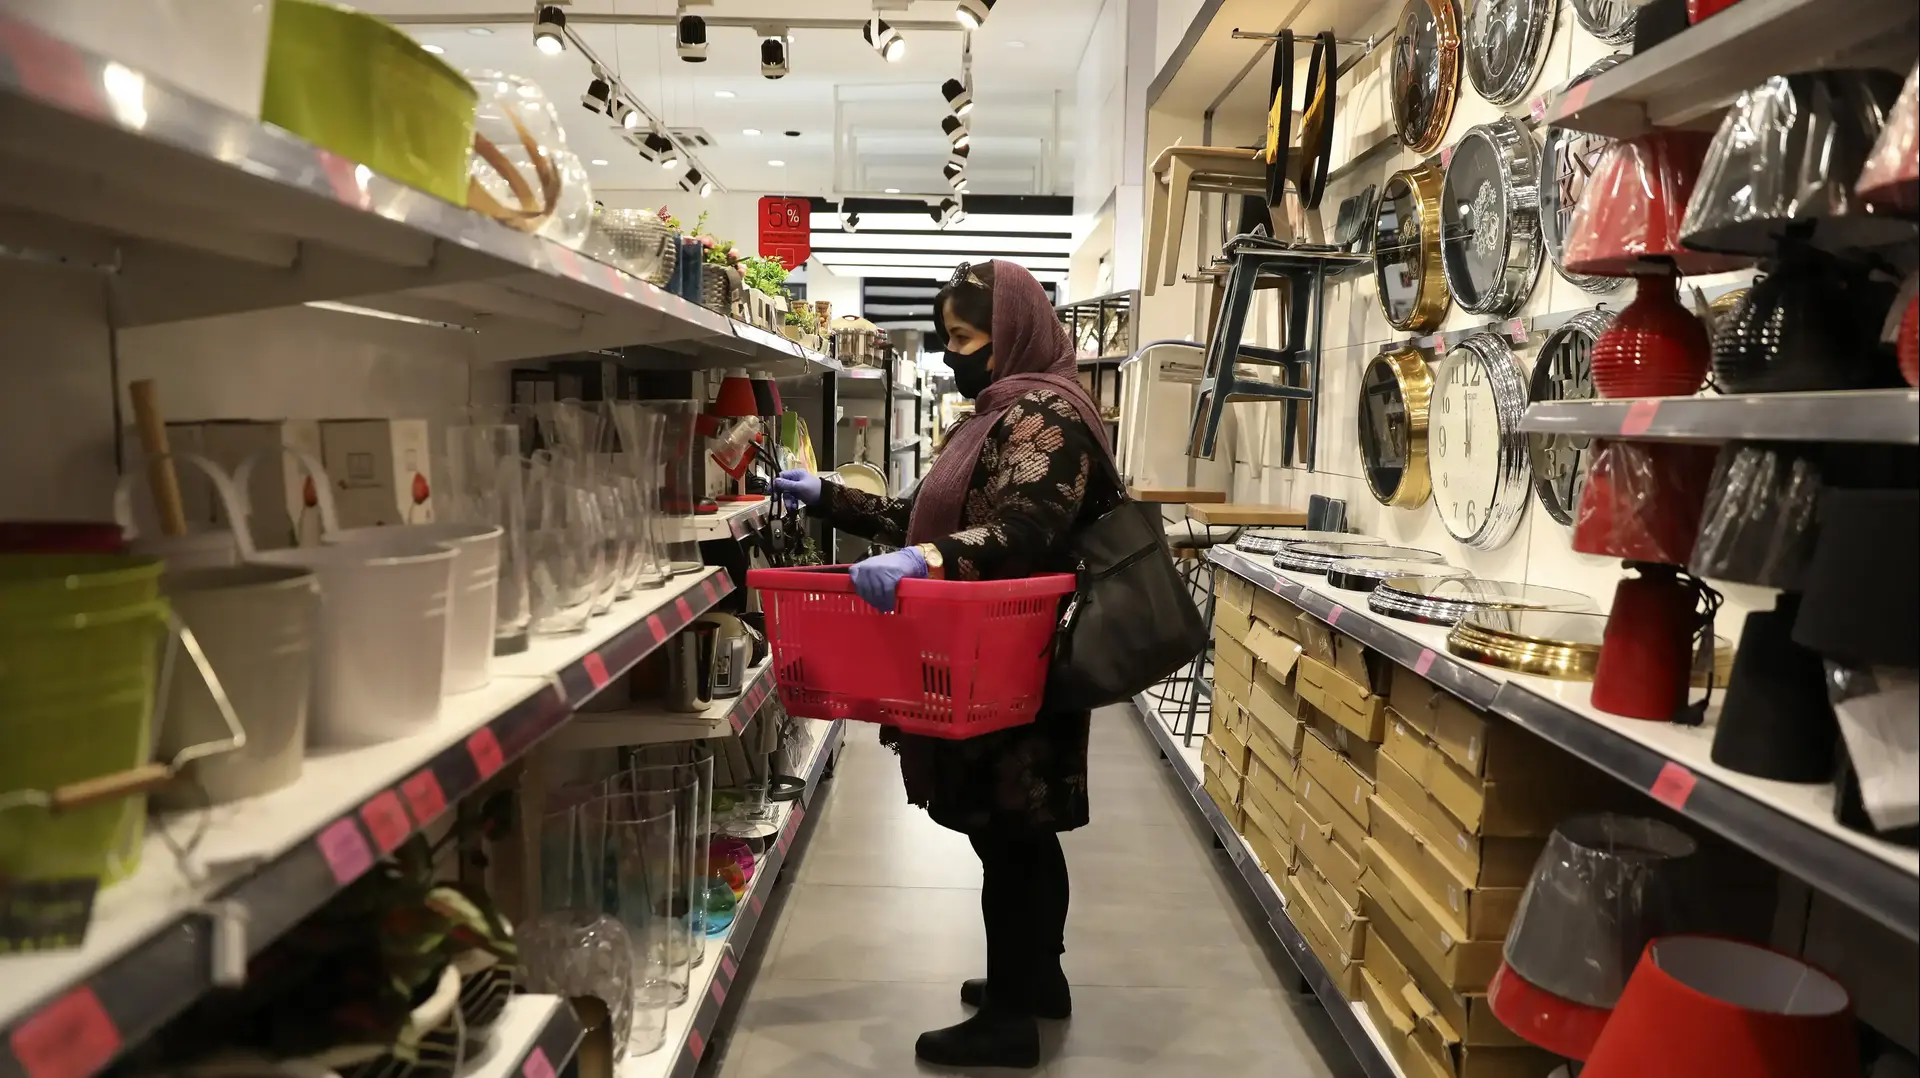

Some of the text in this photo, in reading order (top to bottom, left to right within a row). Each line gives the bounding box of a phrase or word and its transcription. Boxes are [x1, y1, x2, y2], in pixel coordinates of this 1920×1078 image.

[1451, 366, 1460, 384] 11
[1462, 352, 1480, 387] 12
[1442, 396, 1451, 414] 10
[1439, 426, 1447, 457] 9
[1443, 472, 1448, 488] 8
[1453, 502, 1458, 518] 7
[1466, 500, 1477, 534] 6
